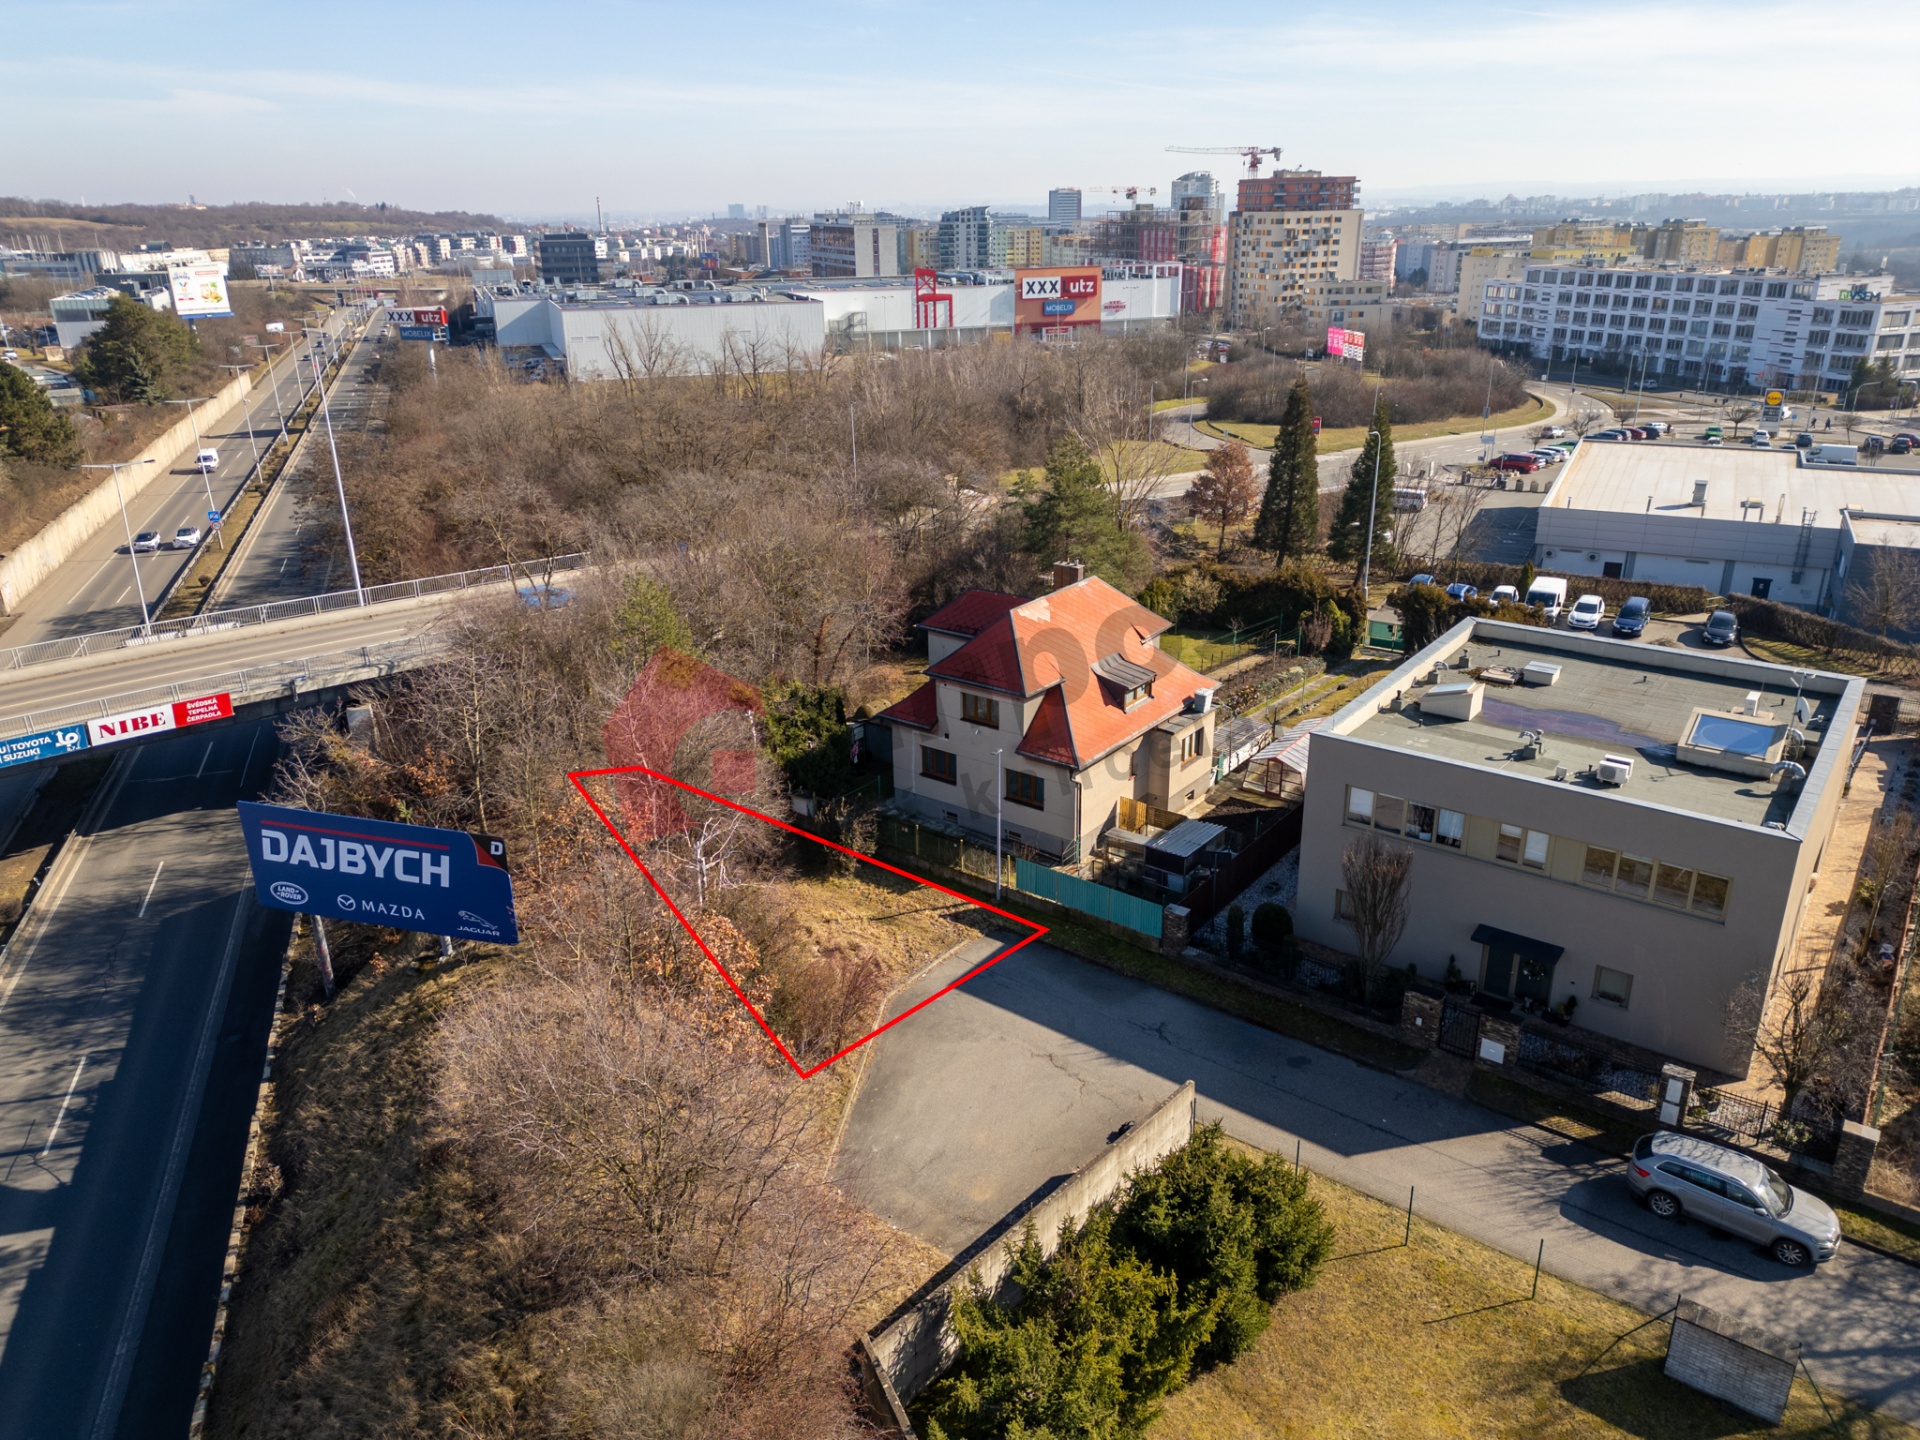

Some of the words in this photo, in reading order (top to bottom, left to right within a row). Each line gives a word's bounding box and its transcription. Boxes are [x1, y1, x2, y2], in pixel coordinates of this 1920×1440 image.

[186, 697, 218, 709] ŠVÉDSKÁ
[188, 704, 219, 715] TEPELNÁ
[186, 710, 222, 722] ČERPADLA
[98, 712, 167, 739] NIBE
[10, 736, 52, 751] TOYOTA
[3, 747, 40, 762] SUZUKI
[261, 829, 450, 888] DAJBYCH
[277, 885, 295, 894] LAND
[280, 891, 302, 901] ROVER
[361, 900, 425, 921] MAZDA
[457, 925, 500, 937] JAGUAR
